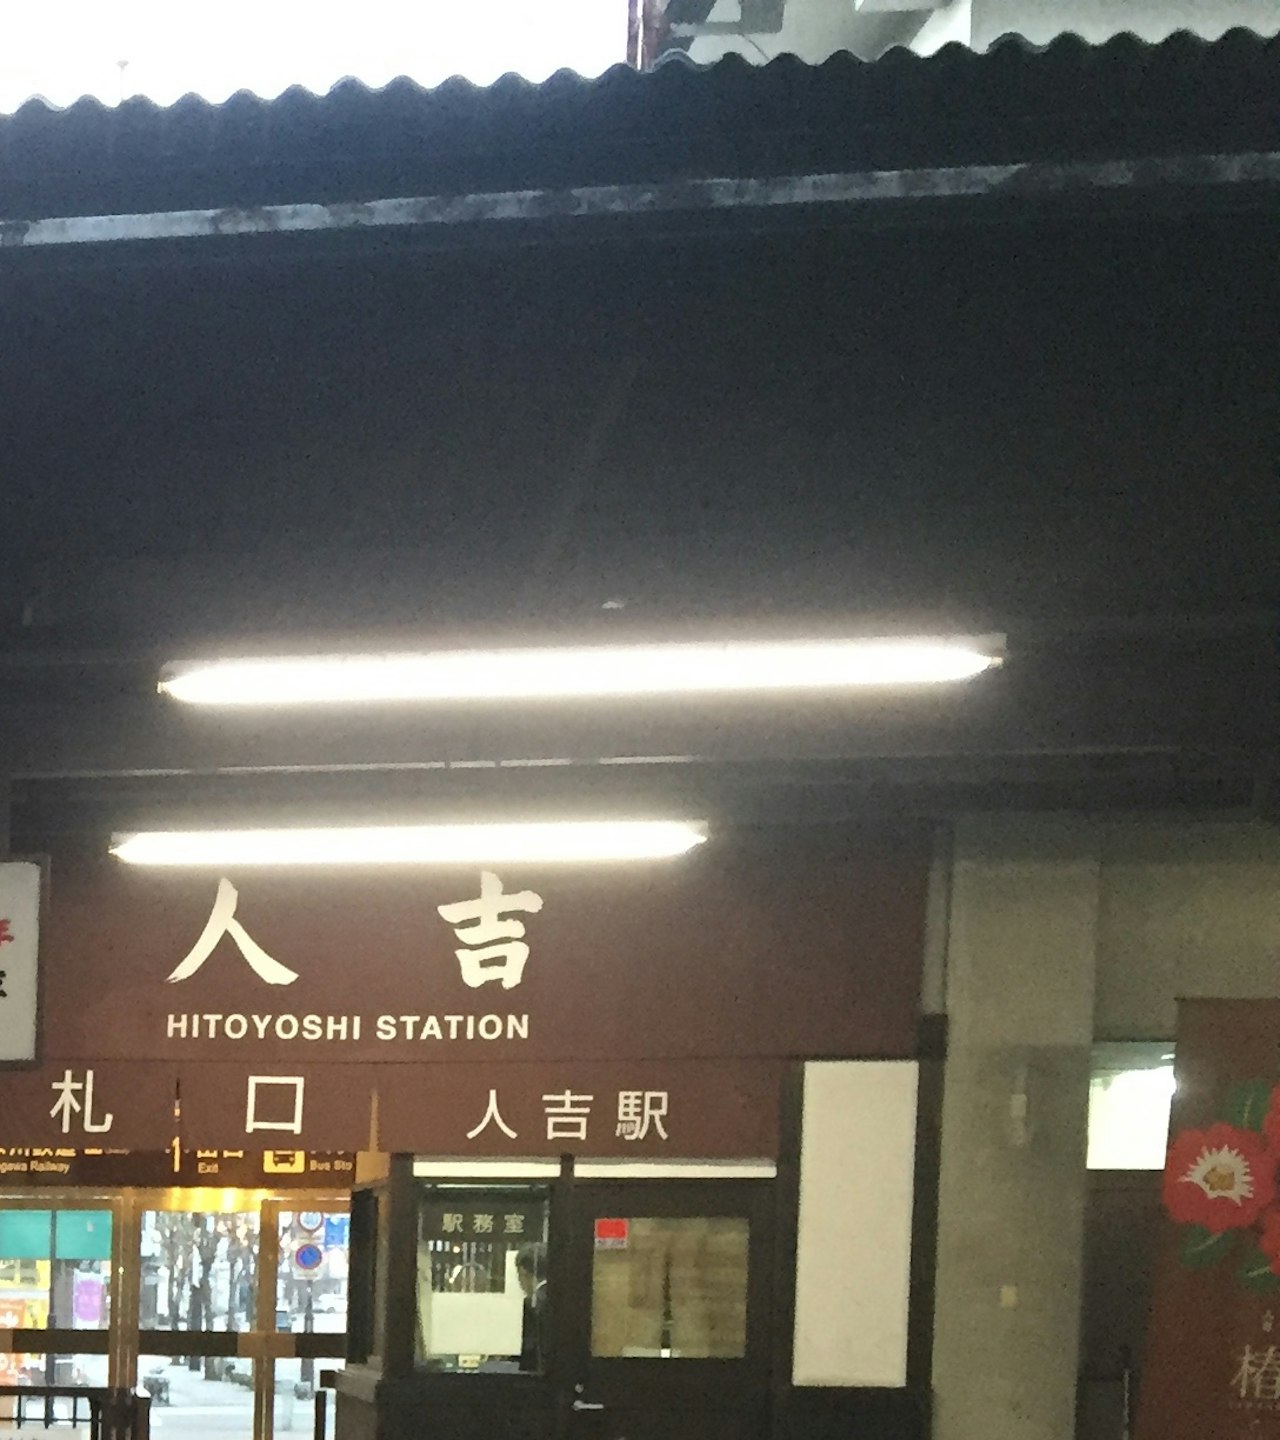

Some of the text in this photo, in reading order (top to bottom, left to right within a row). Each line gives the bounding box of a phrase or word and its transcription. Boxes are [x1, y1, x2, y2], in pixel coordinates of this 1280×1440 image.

[165, 871, 543, 990] 人吉
[167, 1013, 530, 1041] HITOYOSHI STATION
[466, 1089, 670, 1141] 人吉駅
[198, 1162, 219, 1174] Exit
[441, 1212, 526, 1234] 駅務室
